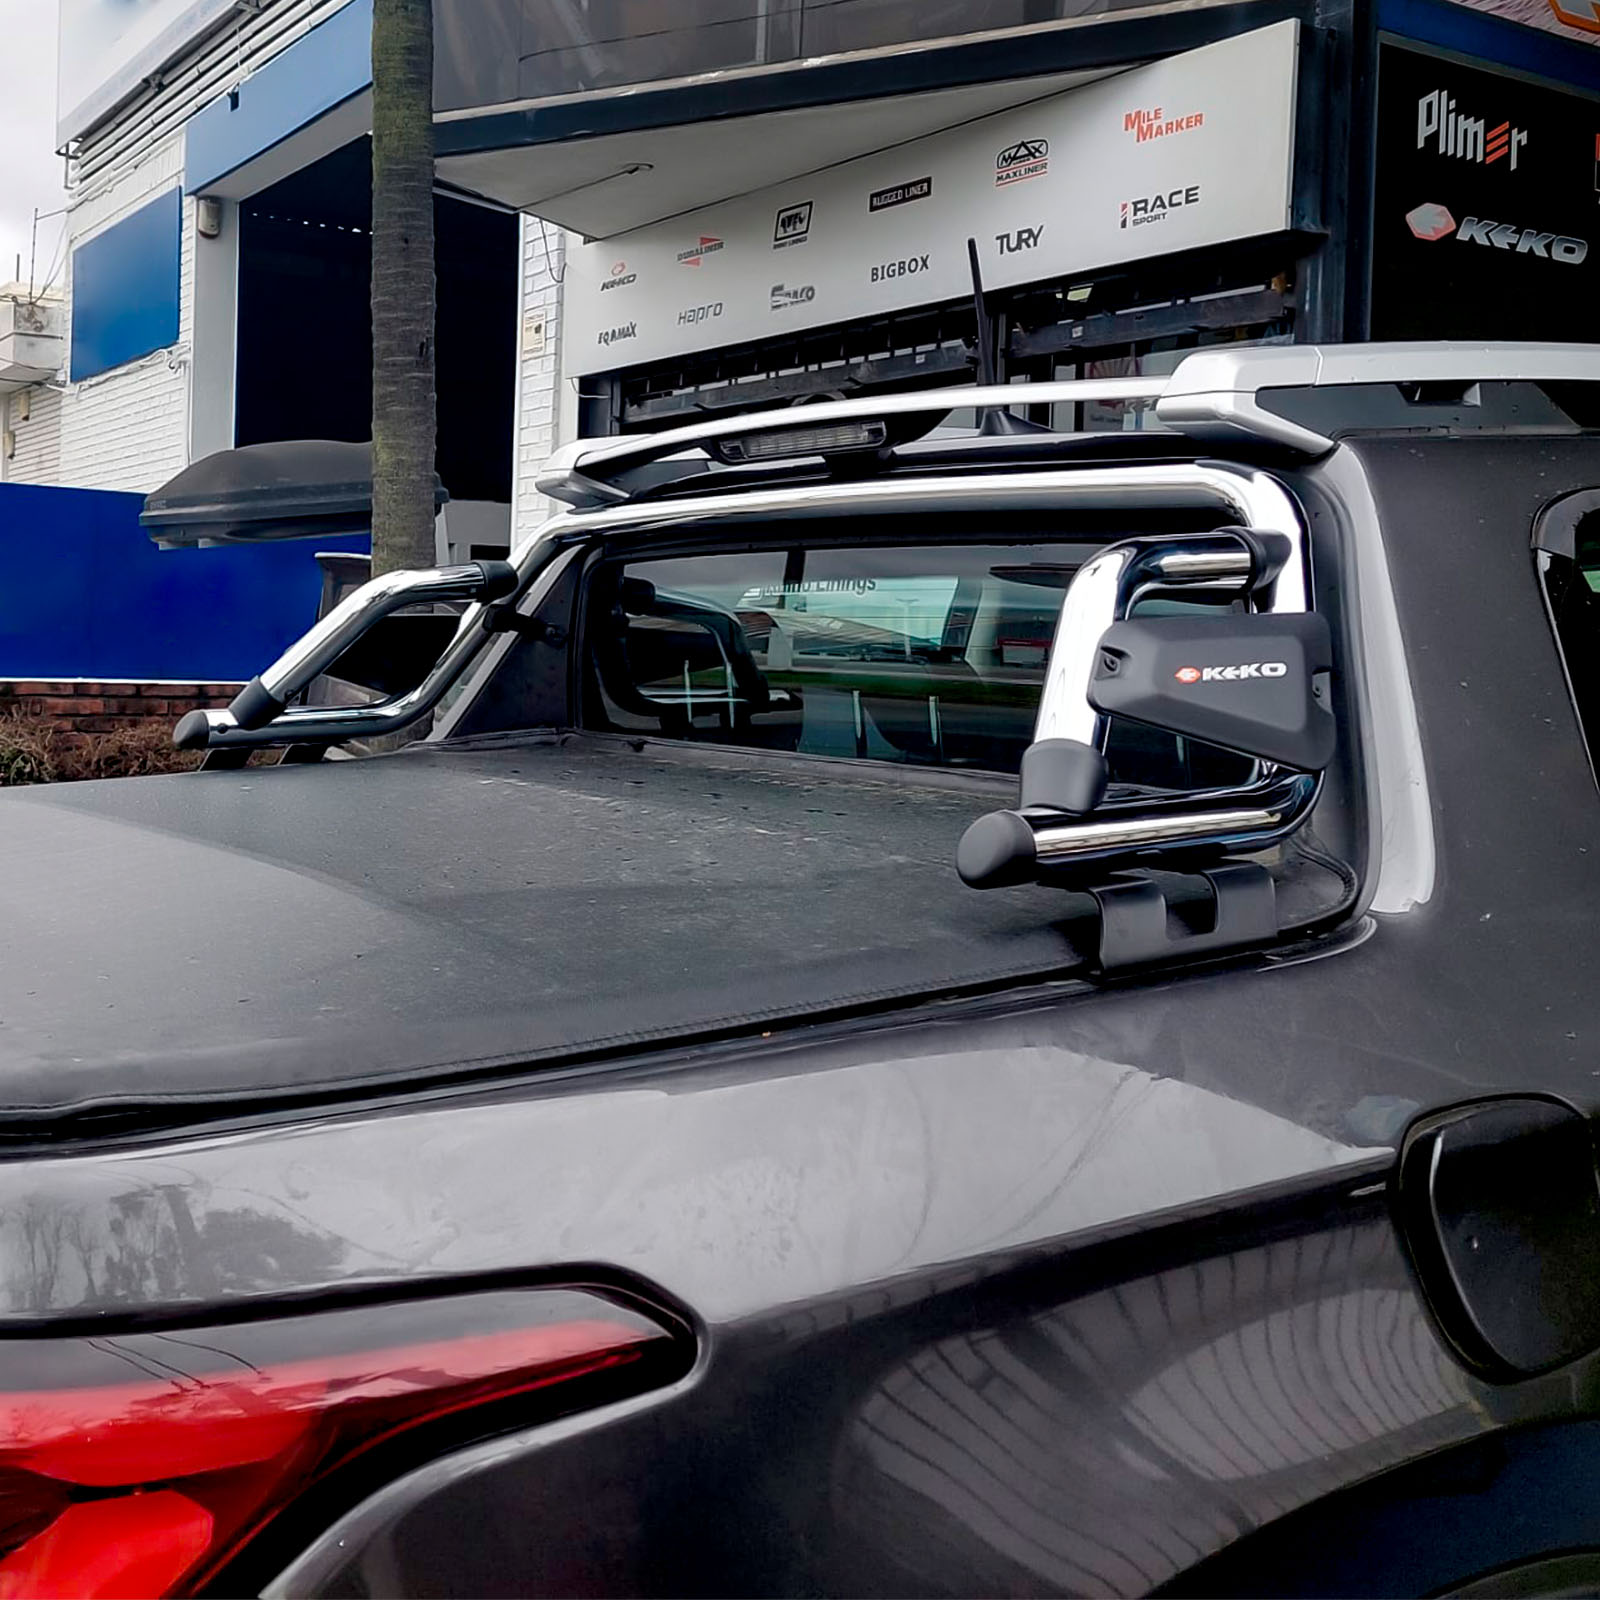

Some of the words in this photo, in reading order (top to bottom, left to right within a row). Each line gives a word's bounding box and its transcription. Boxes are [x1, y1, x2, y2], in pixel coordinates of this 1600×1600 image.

[1124, 107, 1162, 131] MILE
[1136, 112, 1203, 143] MARKER
[1417, 88, 1528, 171] Plimer
[996, 162, 1048, 182] MAXLINER
[1131, 185, 1200, 217] RACE
[1132, 212, 1167, 227] SPORT
[995, 224, 1044, 255] TURY
[871, 254, 930, 283] BIGBOX
